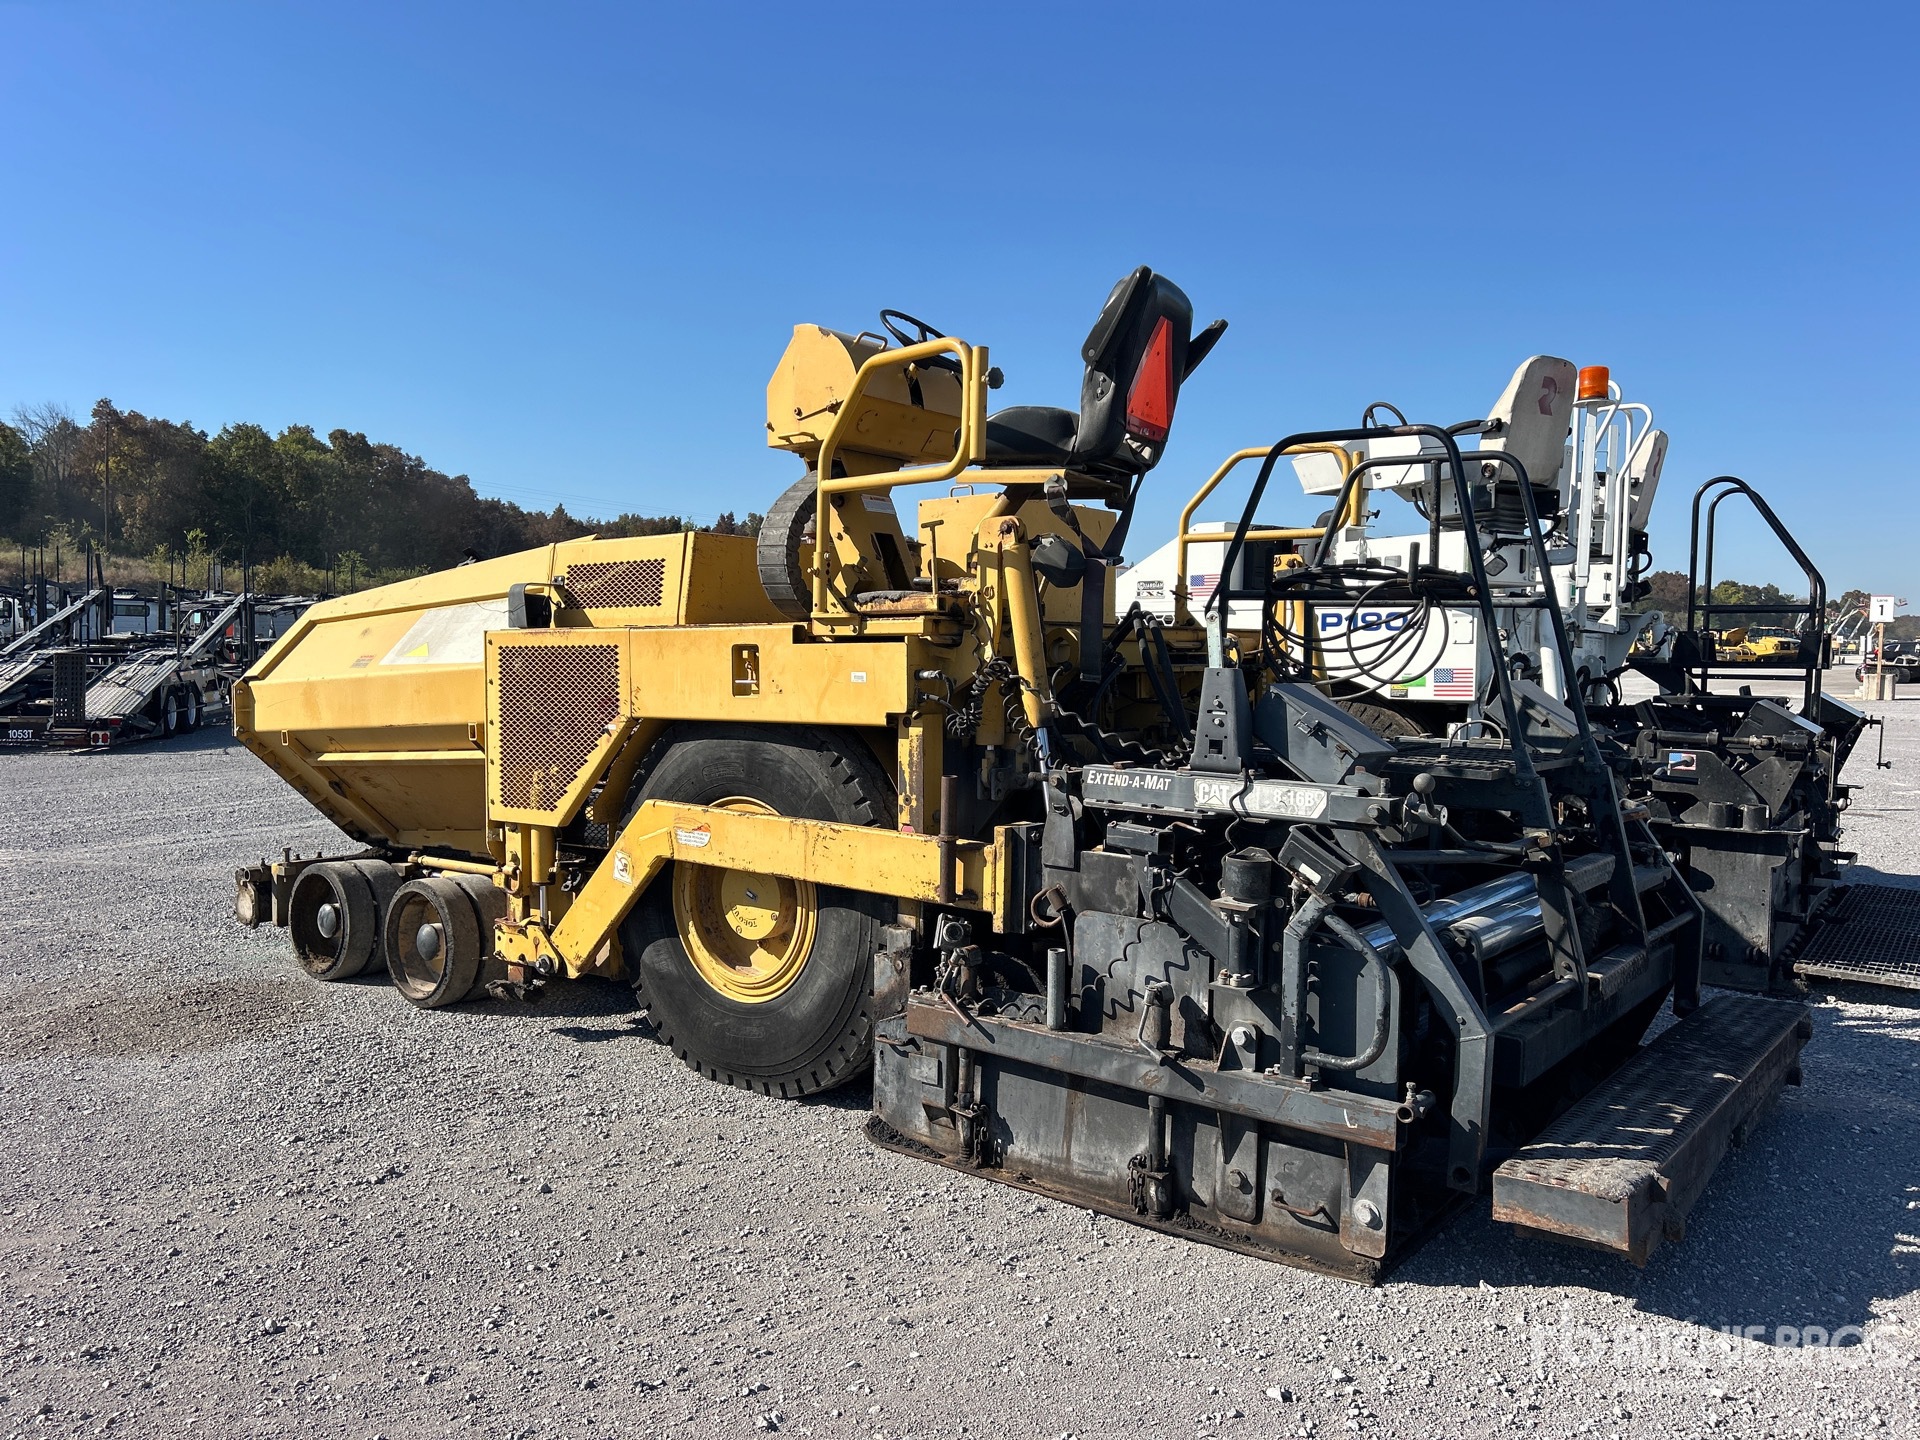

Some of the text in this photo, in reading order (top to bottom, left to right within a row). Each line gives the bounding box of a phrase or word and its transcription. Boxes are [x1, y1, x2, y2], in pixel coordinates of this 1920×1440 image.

[1879, 605, 1884, 616] 1
[8, 730, 33, 739] 1053T
[1199, 783, 1229, 806] CAT
